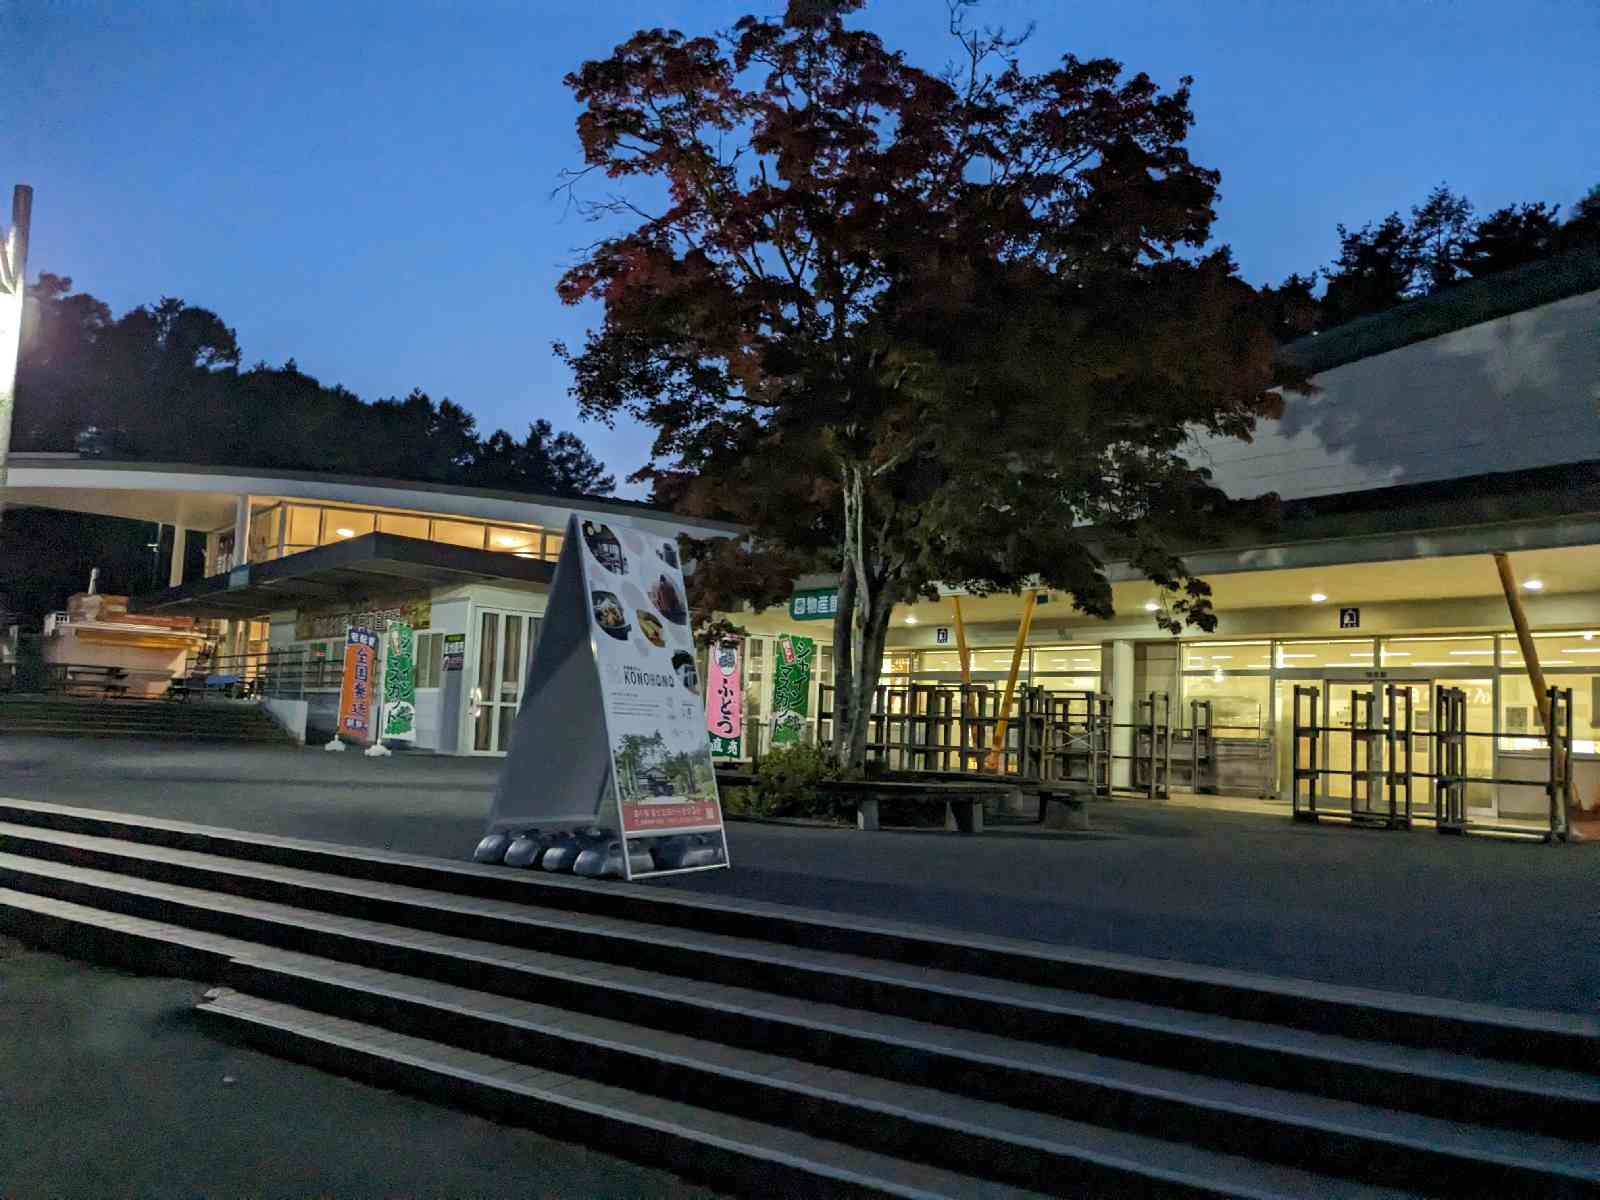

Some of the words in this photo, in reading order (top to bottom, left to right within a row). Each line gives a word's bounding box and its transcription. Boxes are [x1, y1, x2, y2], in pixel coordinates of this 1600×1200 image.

[387, 656, 402, 724] マスカット
[774, 665, 792, 732] マスカット
[789, 640, 811, 707] シャイン
[711, 737, 738, 756] 直売
